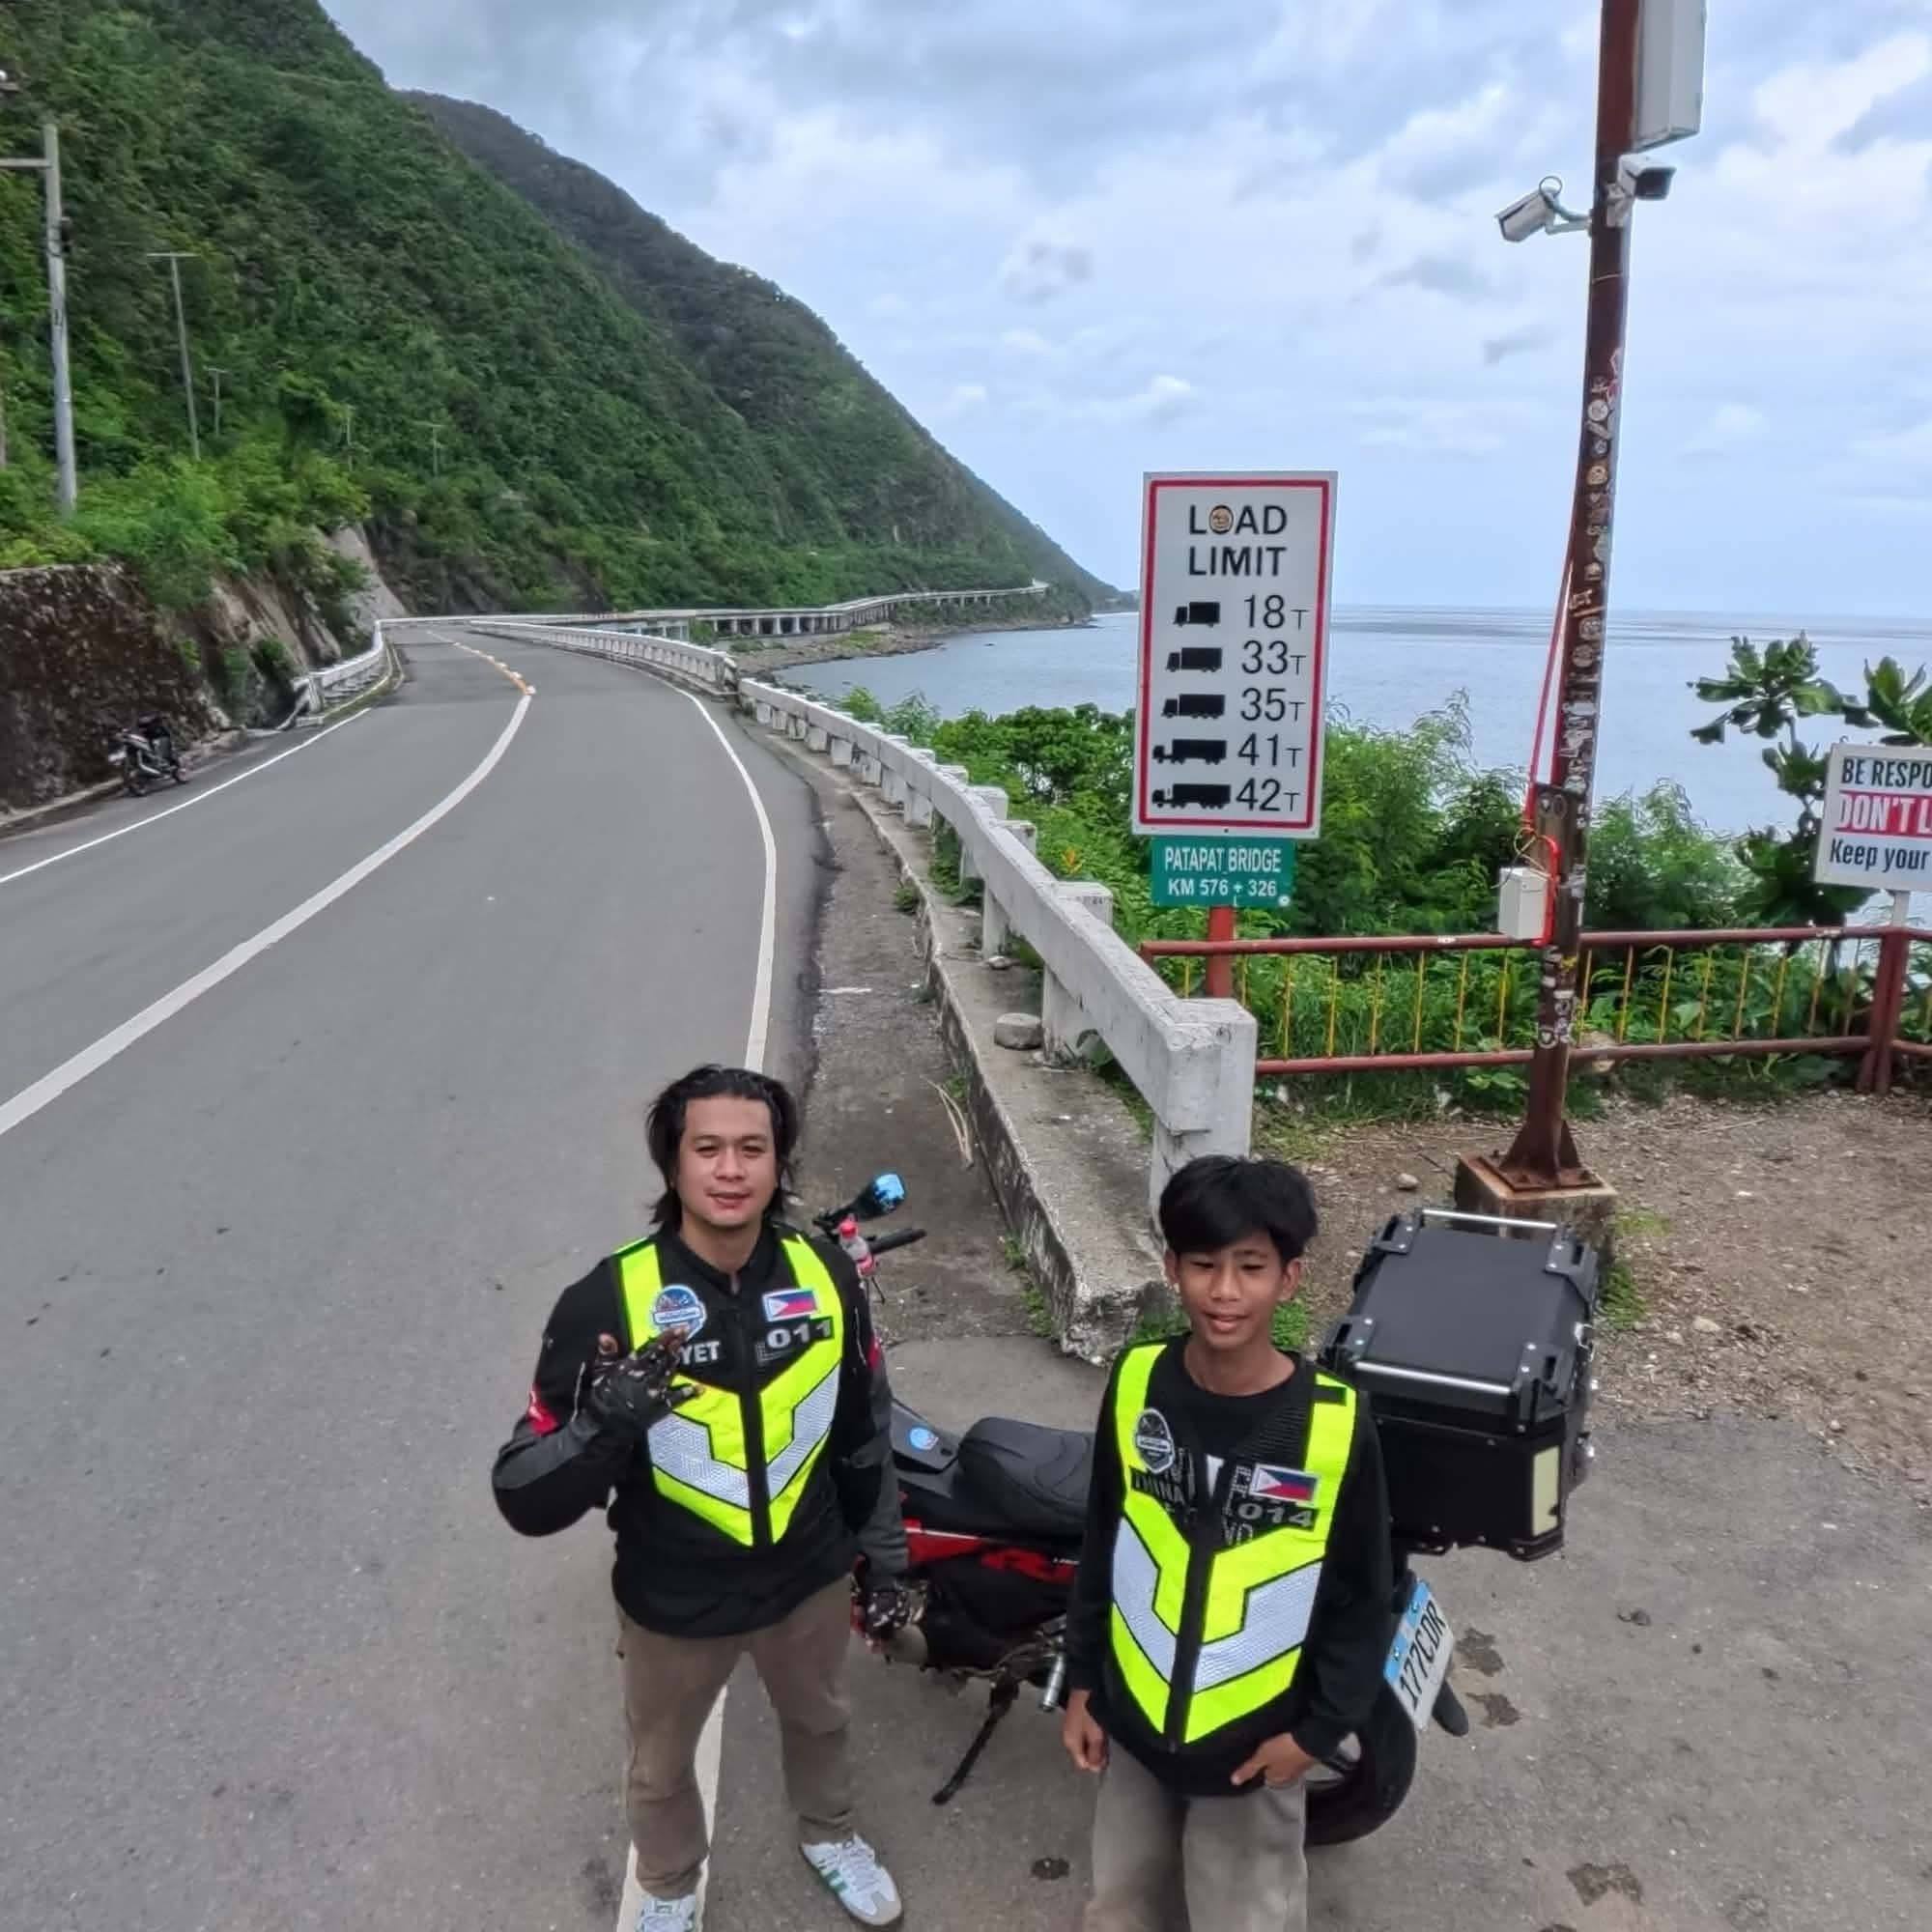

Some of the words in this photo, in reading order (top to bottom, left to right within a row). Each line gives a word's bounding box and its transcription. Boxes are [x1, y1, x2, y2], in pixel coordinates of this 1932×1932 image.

[1189, 504, 1288, 534] LOAD
[1188, 546, 1288, 577] LIMIT
[1841, 756, 1867, 785] BE
[1871, 758, 1932, 788] RESPO
[1838, 792, 1916, 834] DON'T
[1165, 846, 1224, 872] PATAPAT
[1228, 847, 1282, 873] BRIDGE
[1829, 838, 1878, 870] Keep
[1881, 846, 1930, 872] your
[1168, 879, 1194, 896] KM
[1199, 879, 1229, 896] 576
[1248, 880, 1277, 897] 326
[766, 1320, 832, 1350] 011
[679, 1341, 721, 1365] YET
[1399, 1600, 1447, 1710] 177CDR
